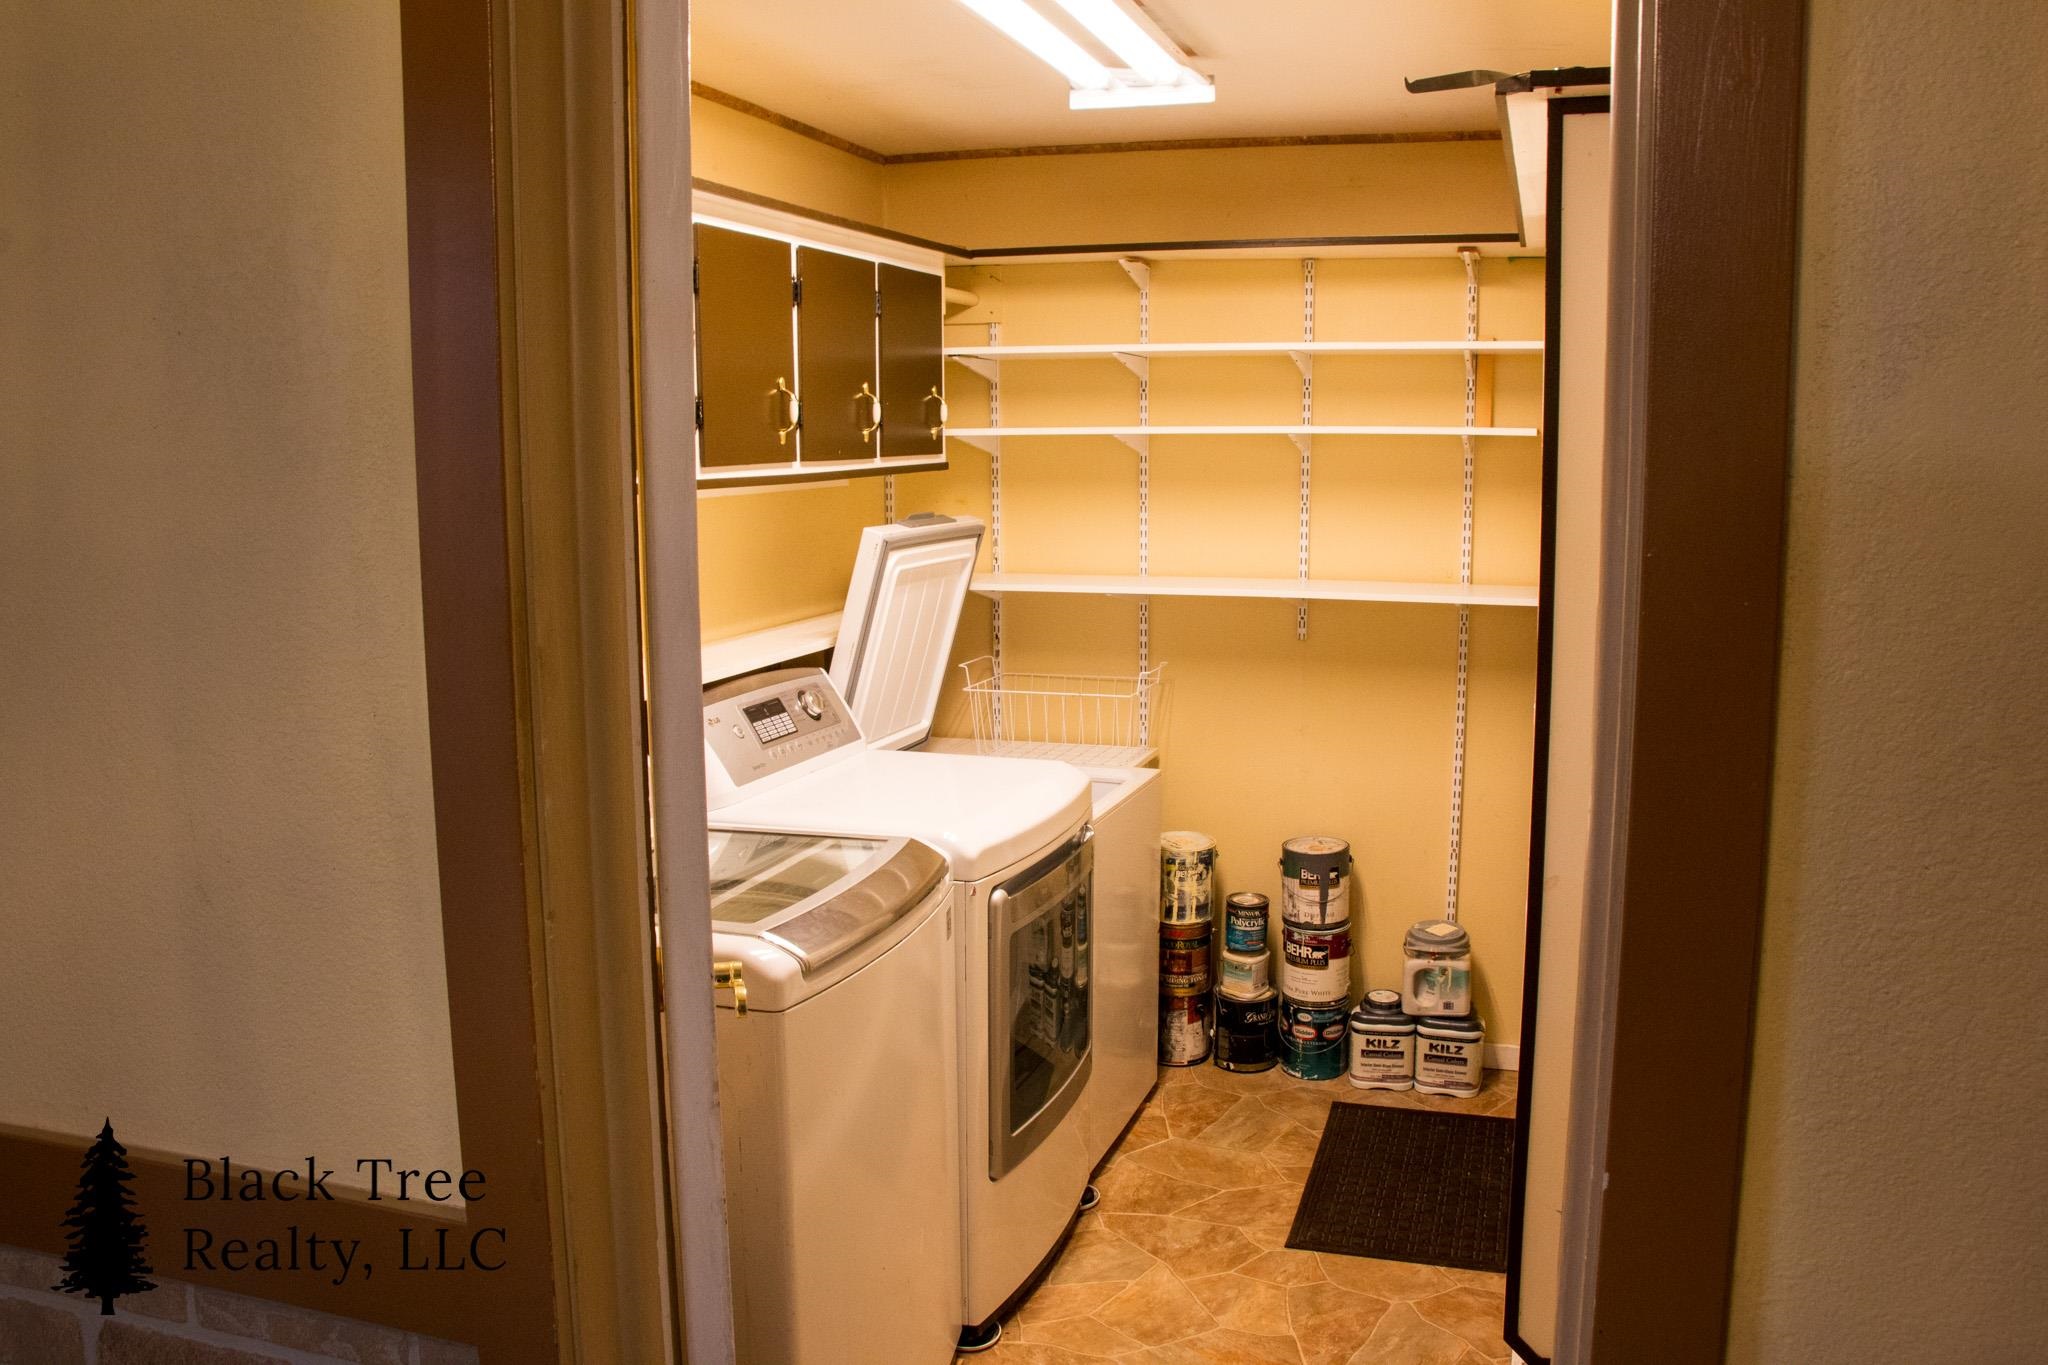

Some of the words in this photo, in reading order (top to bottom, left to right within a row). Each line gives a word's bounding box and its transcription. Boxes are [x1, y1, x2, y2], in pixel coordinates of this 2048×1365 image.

[1230, 915, 1265, 927] Polycrylic
[1286, 940, 1313, 959] BEHR
[1310, 958, 1326, 966] PLUS
[1311, 989, 1331, 997] WHITE
[1365, 1038, 1401, 1049] KILZ
[1428, 1042, 1465, 1055] KILZ
